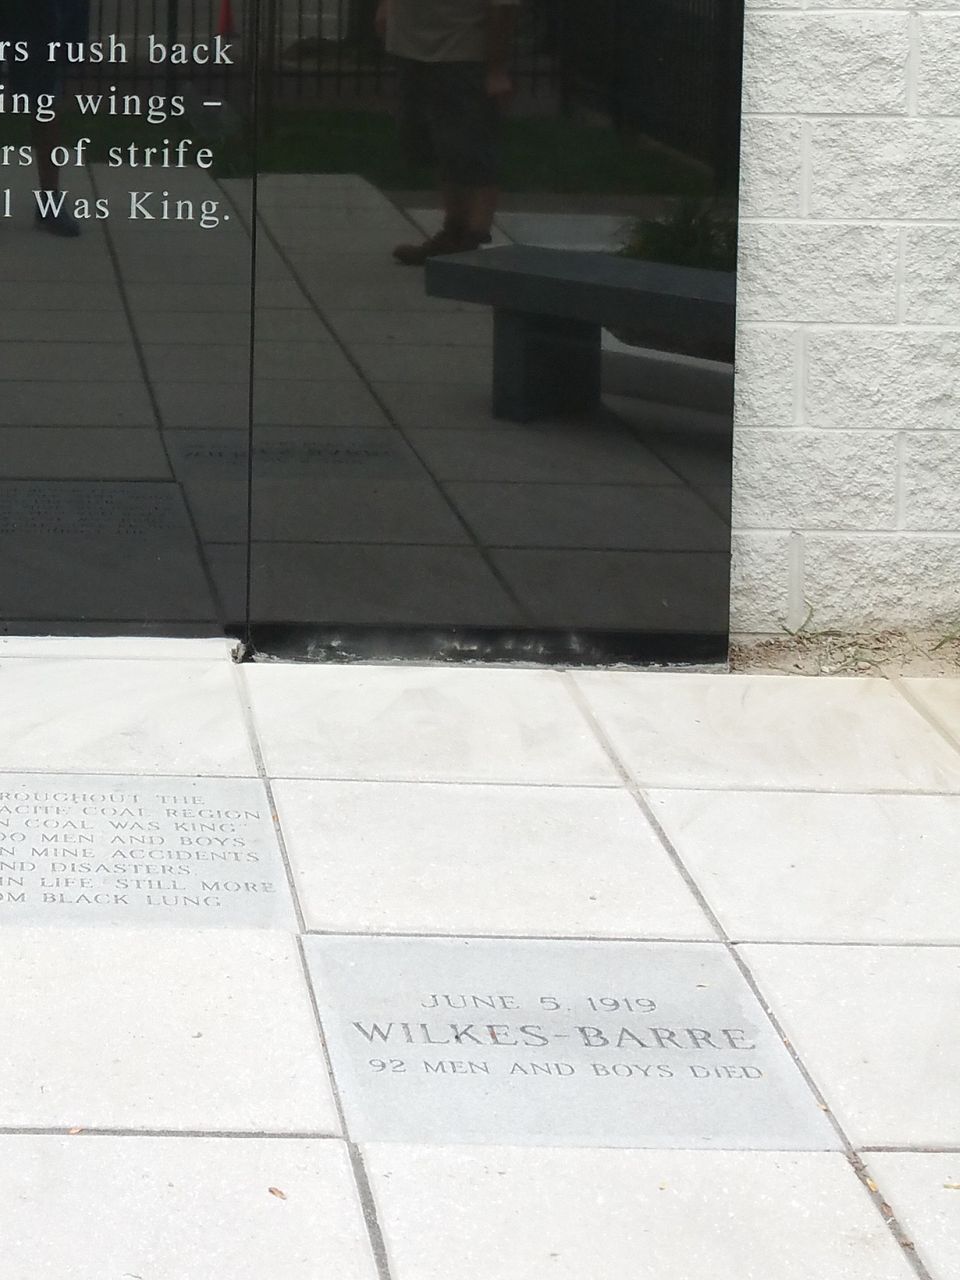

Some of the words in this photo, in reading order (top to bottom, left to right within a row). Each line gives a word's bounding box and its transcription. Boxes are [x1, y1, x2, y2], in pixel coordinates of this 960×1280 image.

[47, 34, 128, 63] rush
[148, 34, 235, 65] back
[75, 86, 185, 123] wings
[50, 138, 91, 167] of
[108, 139, 214, 168] strife
[32, 190, 110, 220] Was
[129, 191, 231, 228] King.
[155, 795, 205, 805] THE
[83, 807, 150, 818] COAL
[166, 808, 261, 821] REGION
[25, 820, 93, 830] COAL
[108, 820, 161, 831] WAS
[41, 833, 95, 844] MEN
[111, 835, 165, 845] AND
[180, 836, 246, 848] BOYS
[31, 847, 95, 858] MINE
[111, 849, 260, 862] ACCIDENTS
[40, 877, 94, 889] LIFE
[115, 878, 186, 891] STILL
[201, 881, 277, 894] MORE
[42, 893, 129, 905] BLACK
[146, 894, 222, 908] LUNG
[421, 993, 521, 1011] JUNE
[587, 996, 657, 1014] 1919
[352, 1021, 757, 1051] WILKES-BARRE
[368, 1058, 406, 1073] 92
[423, 1059, 490, 1075] MEN
[509, 1061, 575, 1077] AND
[592, 1063, 674, 1078] BOYS
[689, 1064, 764, 1080] DIED
